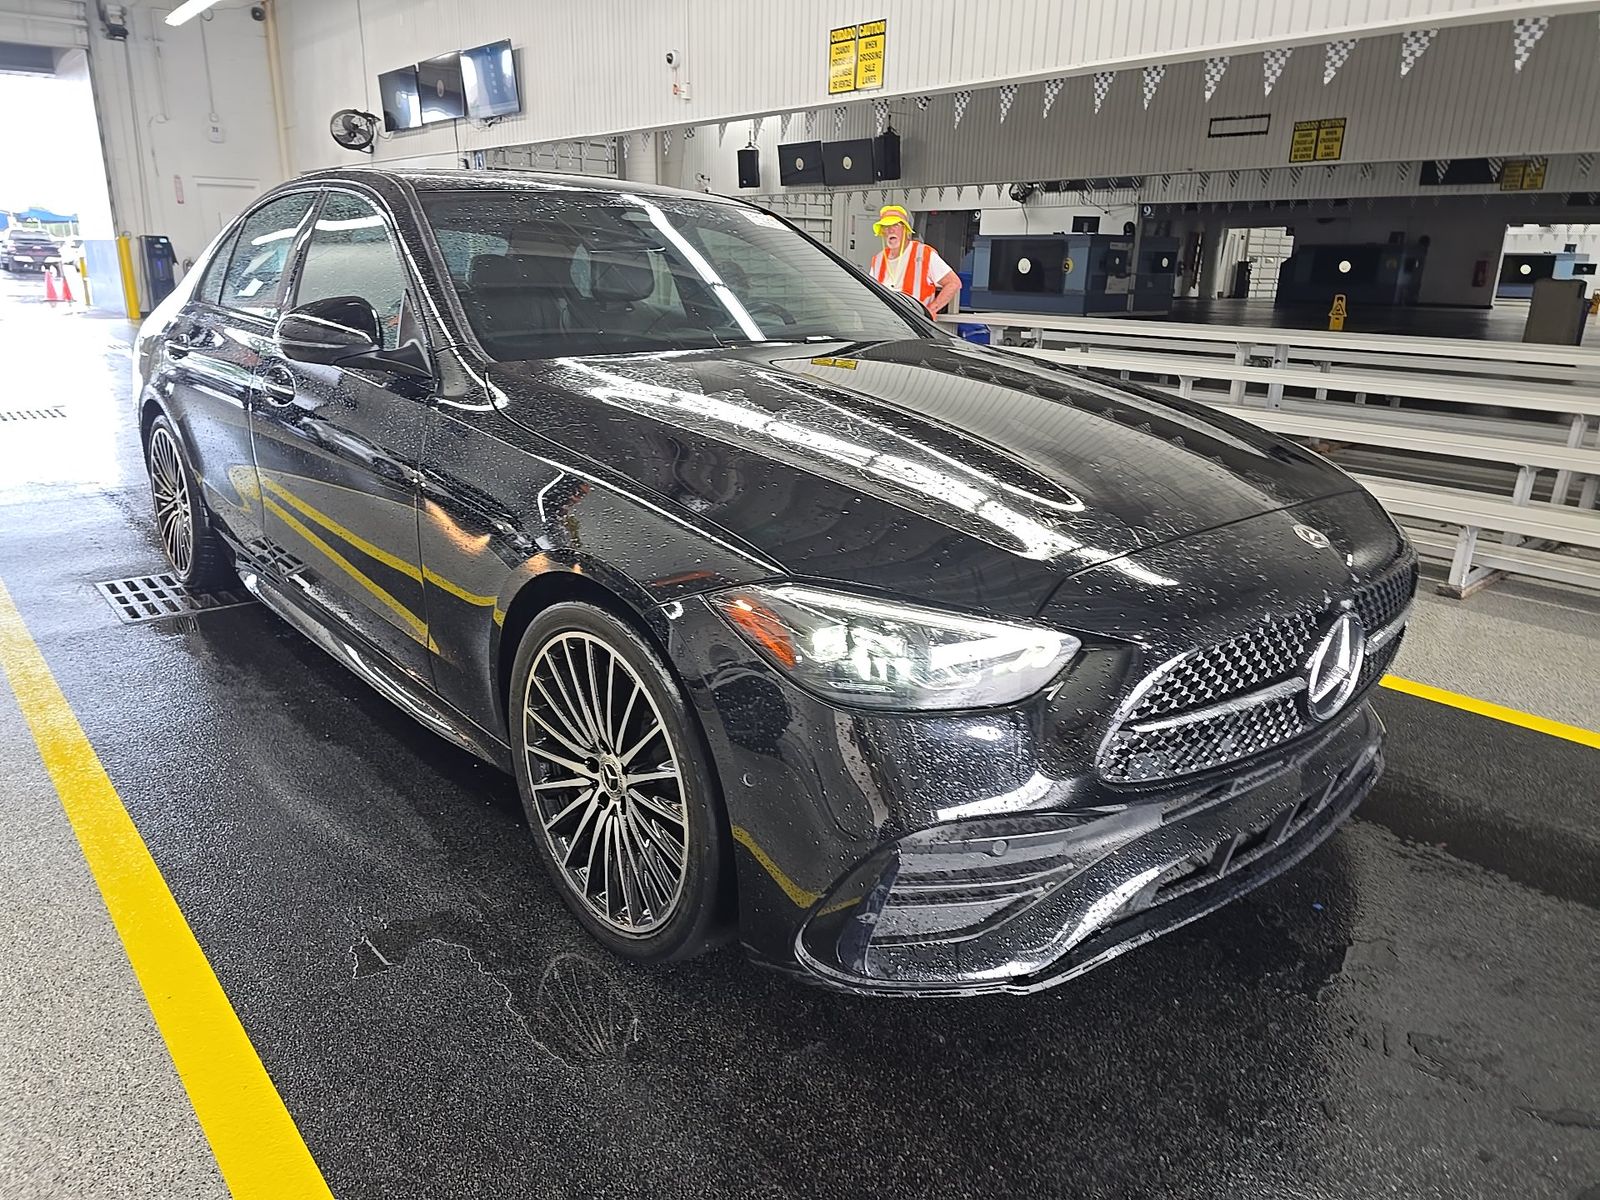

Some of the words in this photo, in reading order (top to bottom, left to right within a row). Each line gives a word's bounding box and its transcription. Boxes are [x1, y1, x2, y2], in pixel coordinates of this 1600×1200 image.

[831, 27, 856, 42] CUIDADO
[860, 20, 885, 37] CAUTION
[860, 50, 882, 62] CROSSING
[1320, 119, 1345, 128] CAUTION
[1143, 205, 1151, 216] 9
